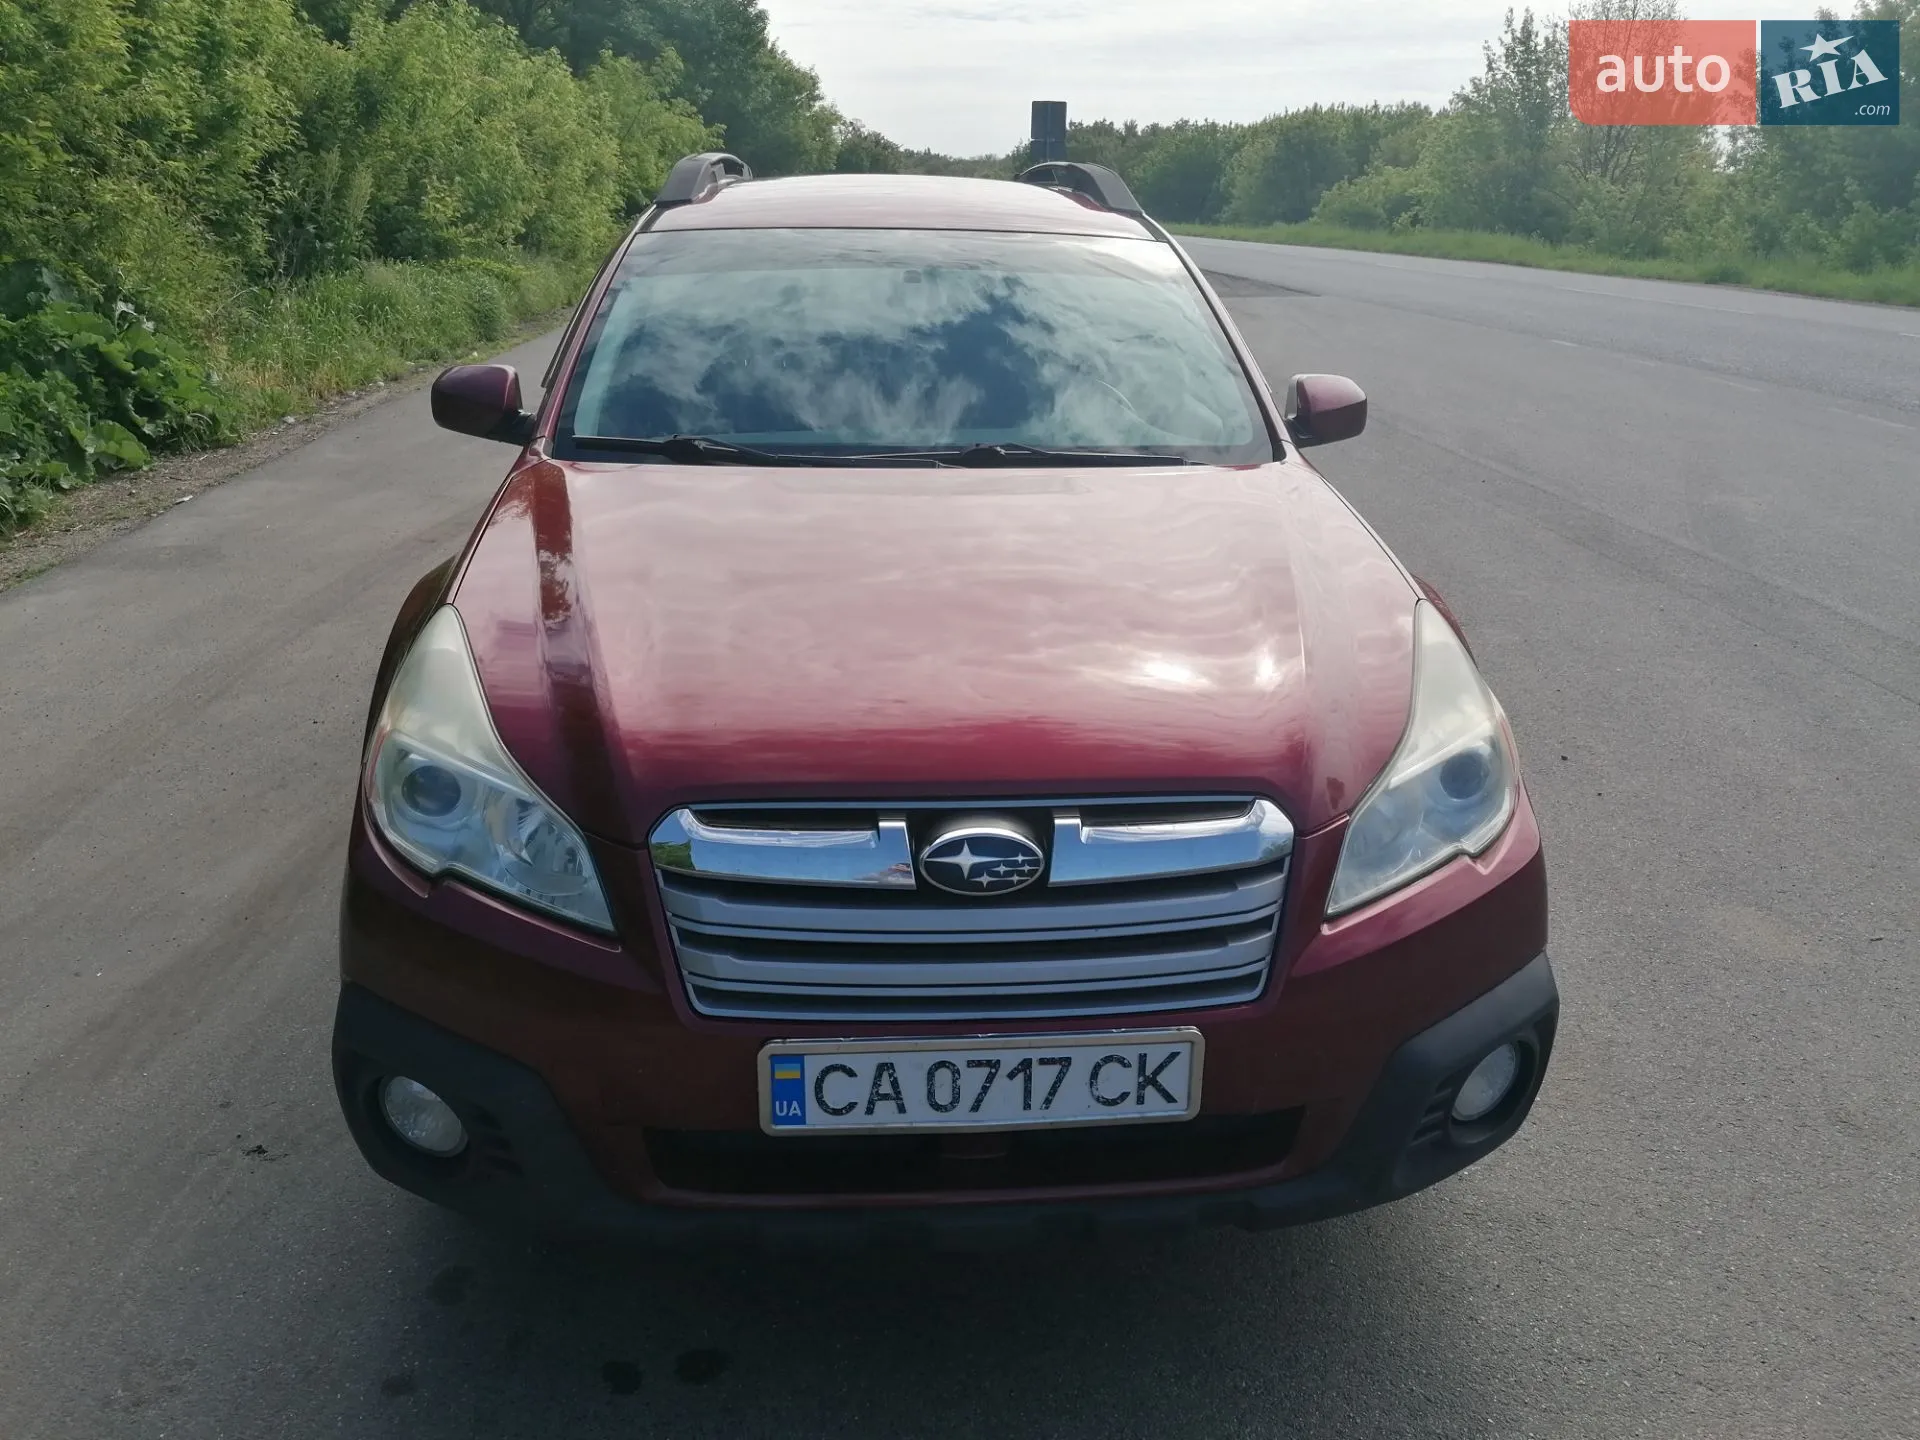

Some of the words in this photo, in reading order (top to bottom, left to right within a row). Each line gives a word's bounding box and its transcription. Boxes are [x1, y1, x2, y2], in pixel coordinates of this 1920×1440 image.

[814, 1061, 907, 1116] CA
[926, 1056, 1073, 1114] 0717
[1089, 1051, 1181, 1107] CK
[775, 1101, 802, 1117] UA
